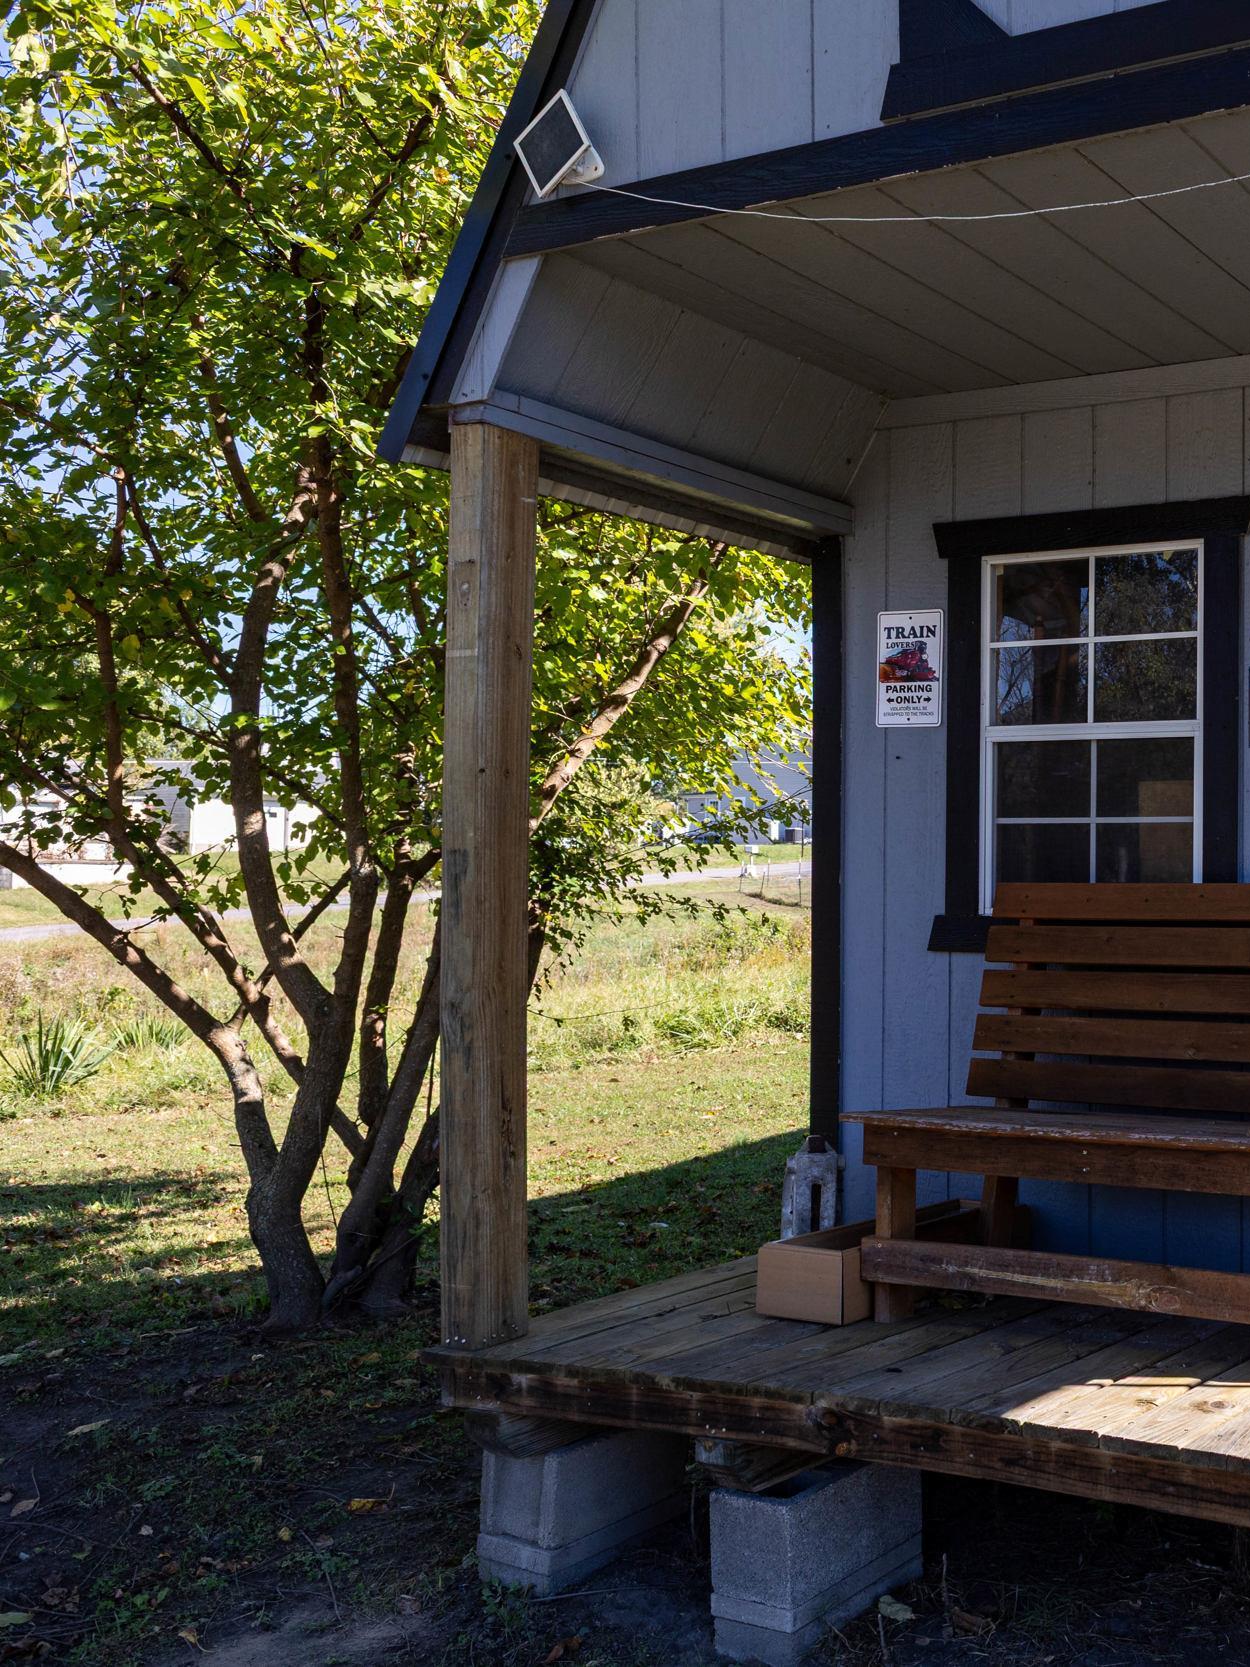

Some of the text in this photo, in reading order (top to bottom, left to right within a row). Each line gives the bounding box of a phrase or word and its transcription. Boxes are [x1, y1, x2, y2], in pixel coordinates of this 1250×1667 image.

[884, 625, 937, 639] TRAIN
[886, 684, 932, 693] PARKING
[896, 696, 923, 704] ONLY
